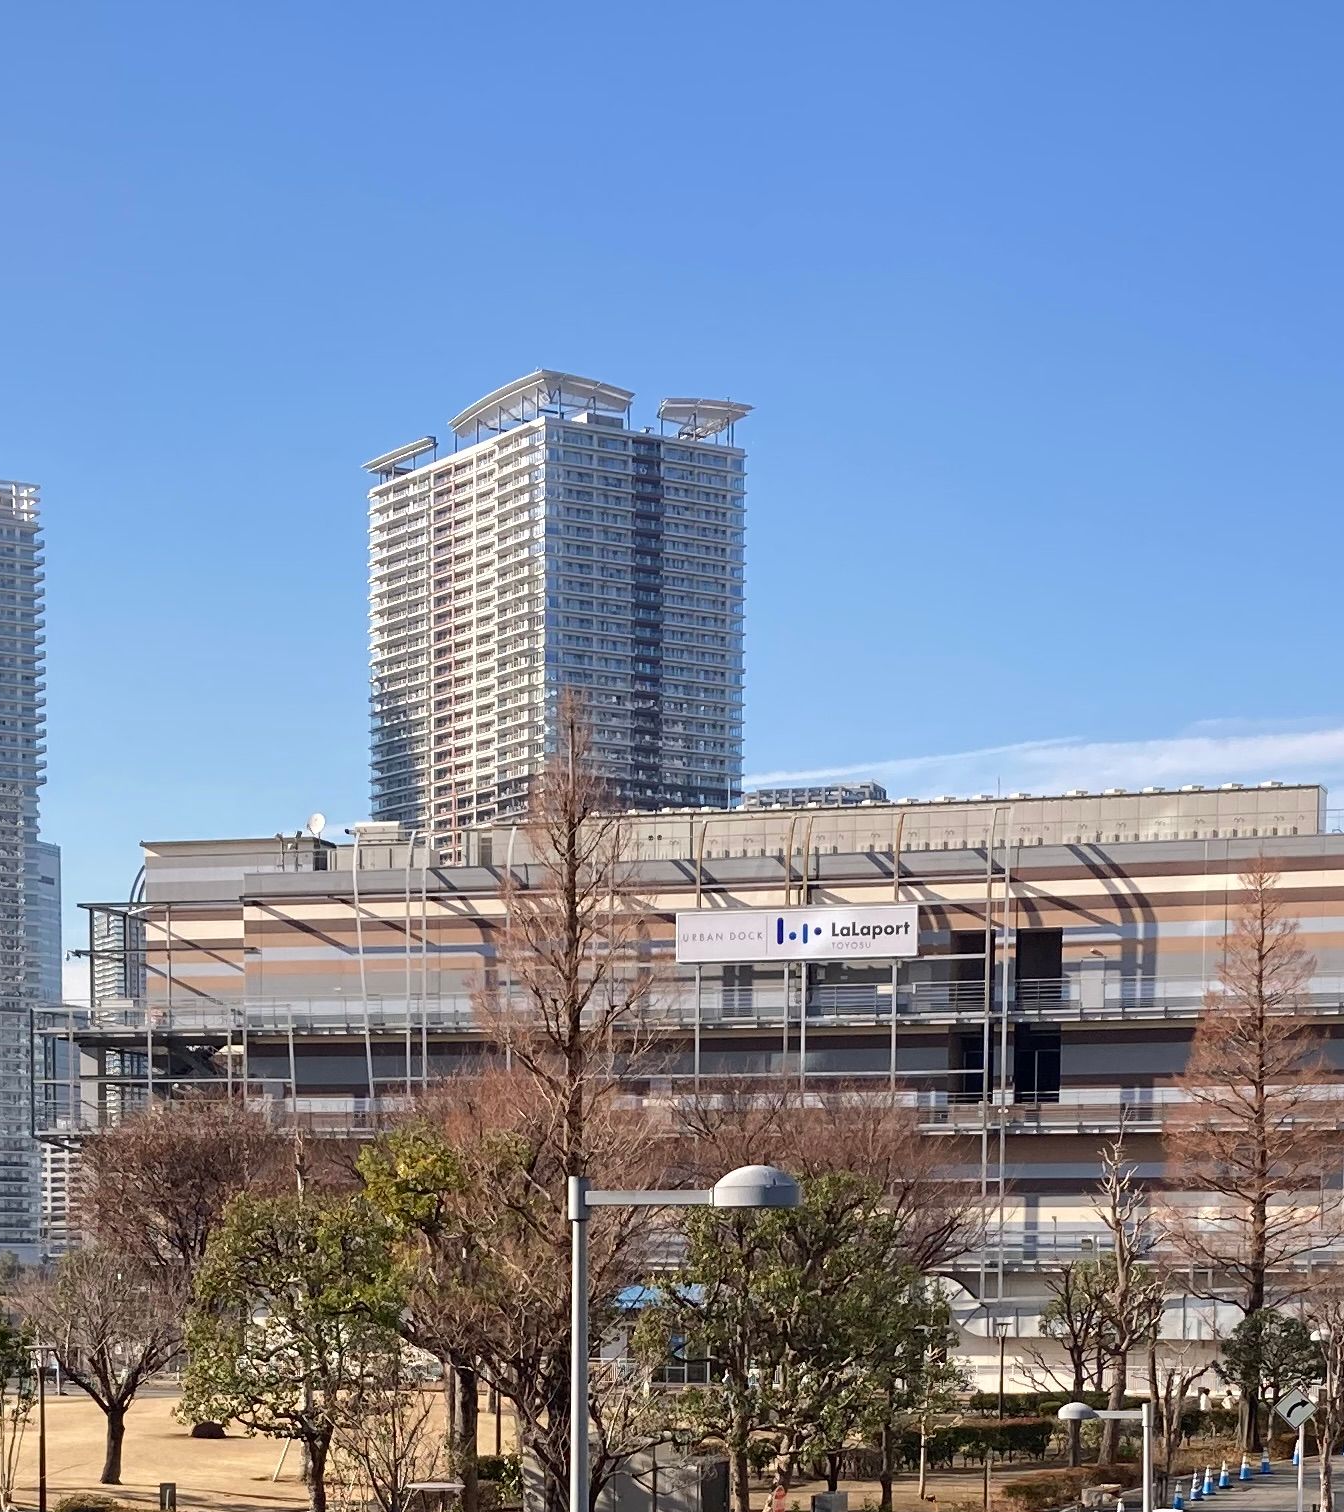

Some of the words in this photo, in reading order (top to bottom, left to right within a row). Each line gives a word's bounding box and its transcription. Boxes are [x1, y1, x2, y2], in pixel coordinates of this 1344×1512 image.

[831, 921, 911, 940] LaLaport
[682, 931, 724, 943] URBAN
[729, 931, 763, 941] DOCK
[831, 941, 872, 950] TOYOSU
